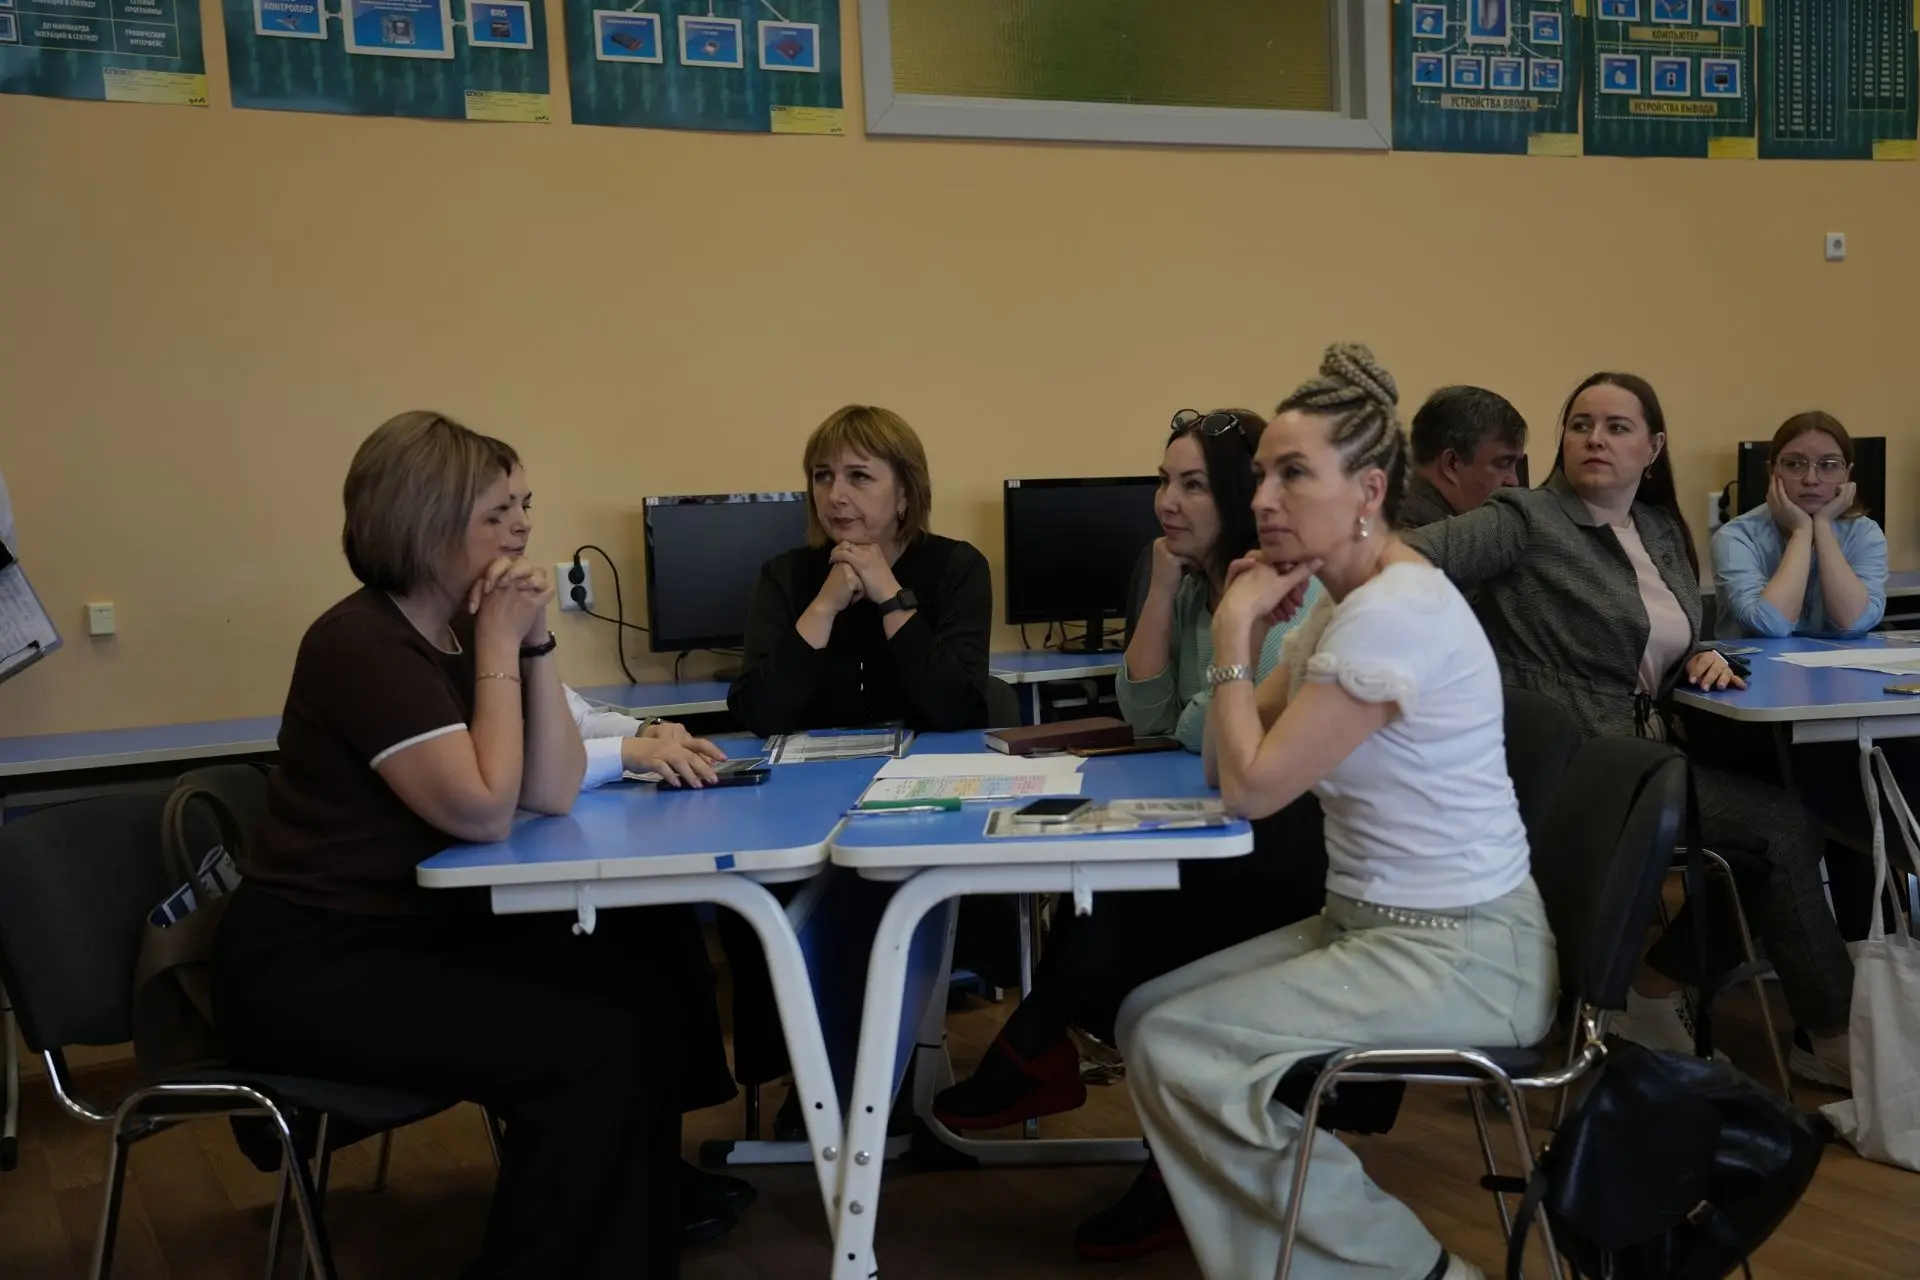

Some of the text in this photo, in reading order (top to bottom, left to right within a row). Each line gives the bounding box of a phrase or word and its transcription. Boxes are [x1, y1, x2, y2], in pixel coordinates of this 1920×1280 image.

[264, 2, 315, 14] КОНТРОЛЛЕР
[490, 8, 508, 17] BIOS
[1652, 29, 1700, 40] КОМПЬЮТЕР
[1450, 95, 1532, 109] УСТРОЙСТВА ВВОДА
[1633, 99, 1714, 114] УСТРОЙСТВА ВЫВОДА
